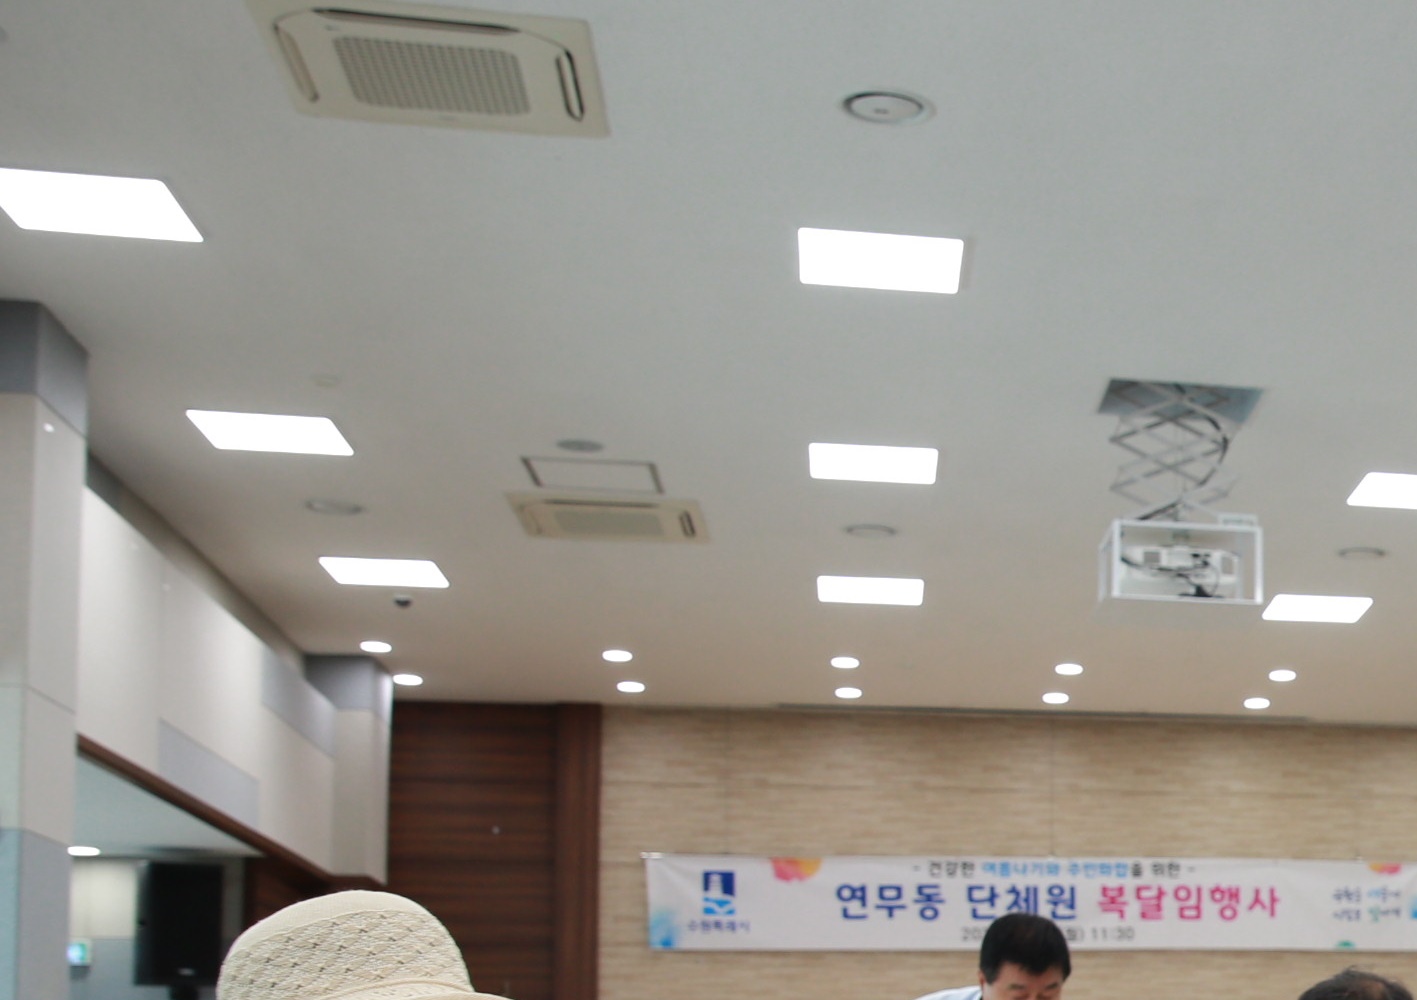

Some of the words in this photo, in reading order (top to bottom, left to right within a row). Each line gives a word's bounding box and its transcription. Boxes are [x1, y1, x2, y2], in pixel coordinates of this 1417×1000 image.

[928, 861, 975, 879] 건강한
[1068, 861, 1143, 879] 주민화합을
[1151, 862, 1181, 878] 위한
[836, 883, 945, 921] 연무동
[967, 884, 1078, 921] 단체원
[1097, 884, 1281, 922] 복달임행사
[1092, 926, 1135, 940] 11:30
